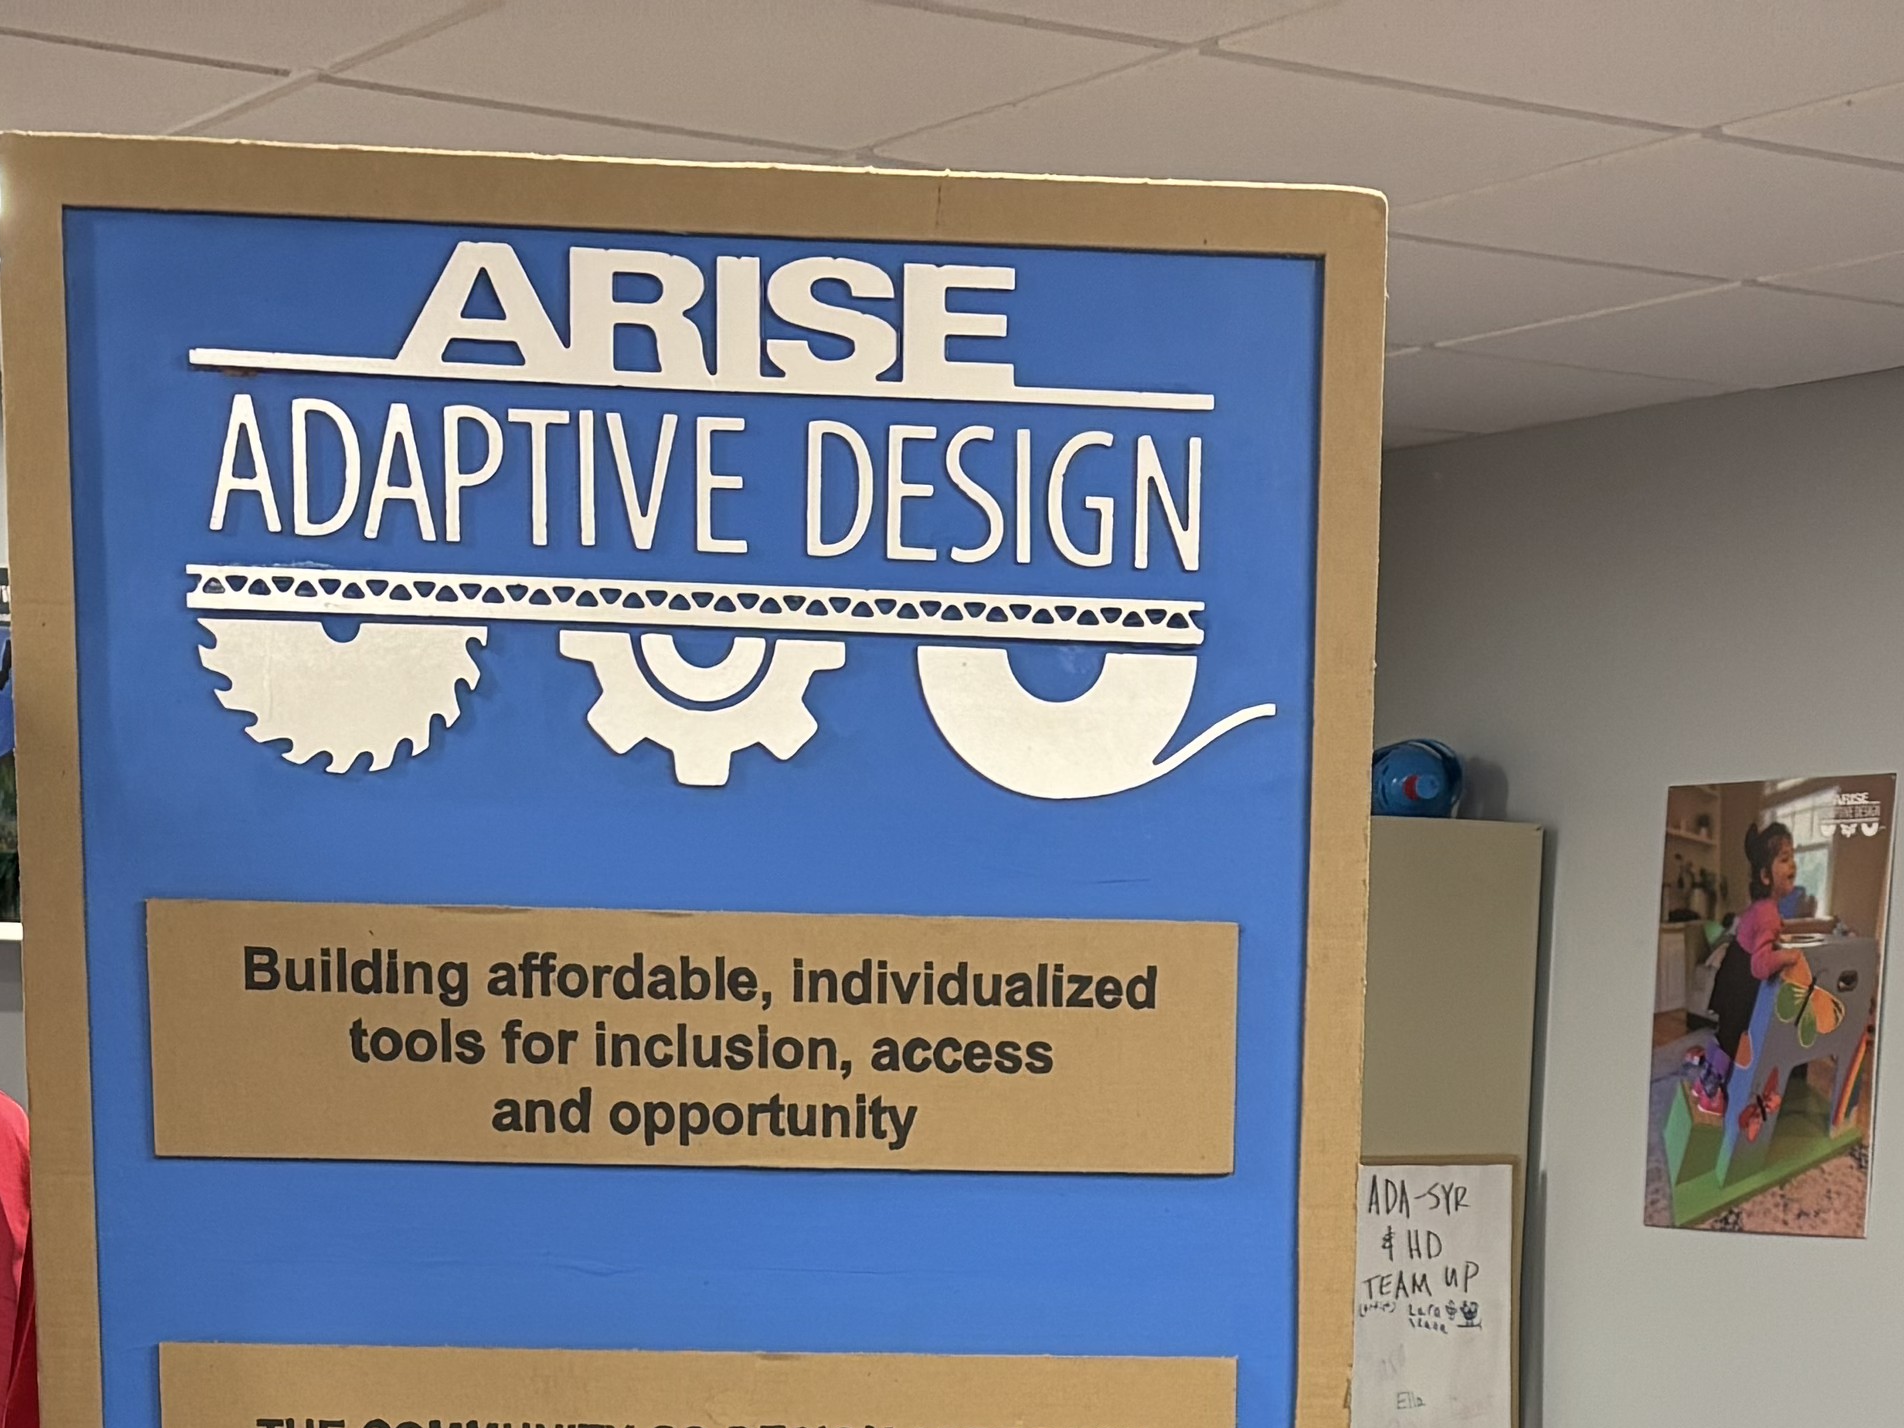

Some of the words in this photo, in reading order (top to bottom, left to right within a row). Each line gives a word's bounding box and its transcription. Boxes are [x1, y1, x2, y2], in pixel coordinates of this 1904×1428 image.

[395, 240, 1016, 386] ARISE
[208, 393, 749, 553] ADAPTIVE
[805, 419, 1203, 571] DESIGN
[243, 945, 469, 1008] Building
[487, 951, 772, 1011] affordable,
[792, 957, 1158, 1010] individualized
[348, 1017, 486, 1065] tools
[501, 1018, 579, 1065] for
[595, 1020, 852, 1081] inclusion,
[870, 1036, 1054, 1075] access
[491, 1086, 592, 1134] and
[609, 1092, 918, 1151] opportunity
[1368, 1174, 1470, 1219] ADA-SYR
[1407, 1229, 1443, 1260] HD
[1362, 1270, 1432, 1301] TEAM
[1445, 1261, 1479, 1293] UP
